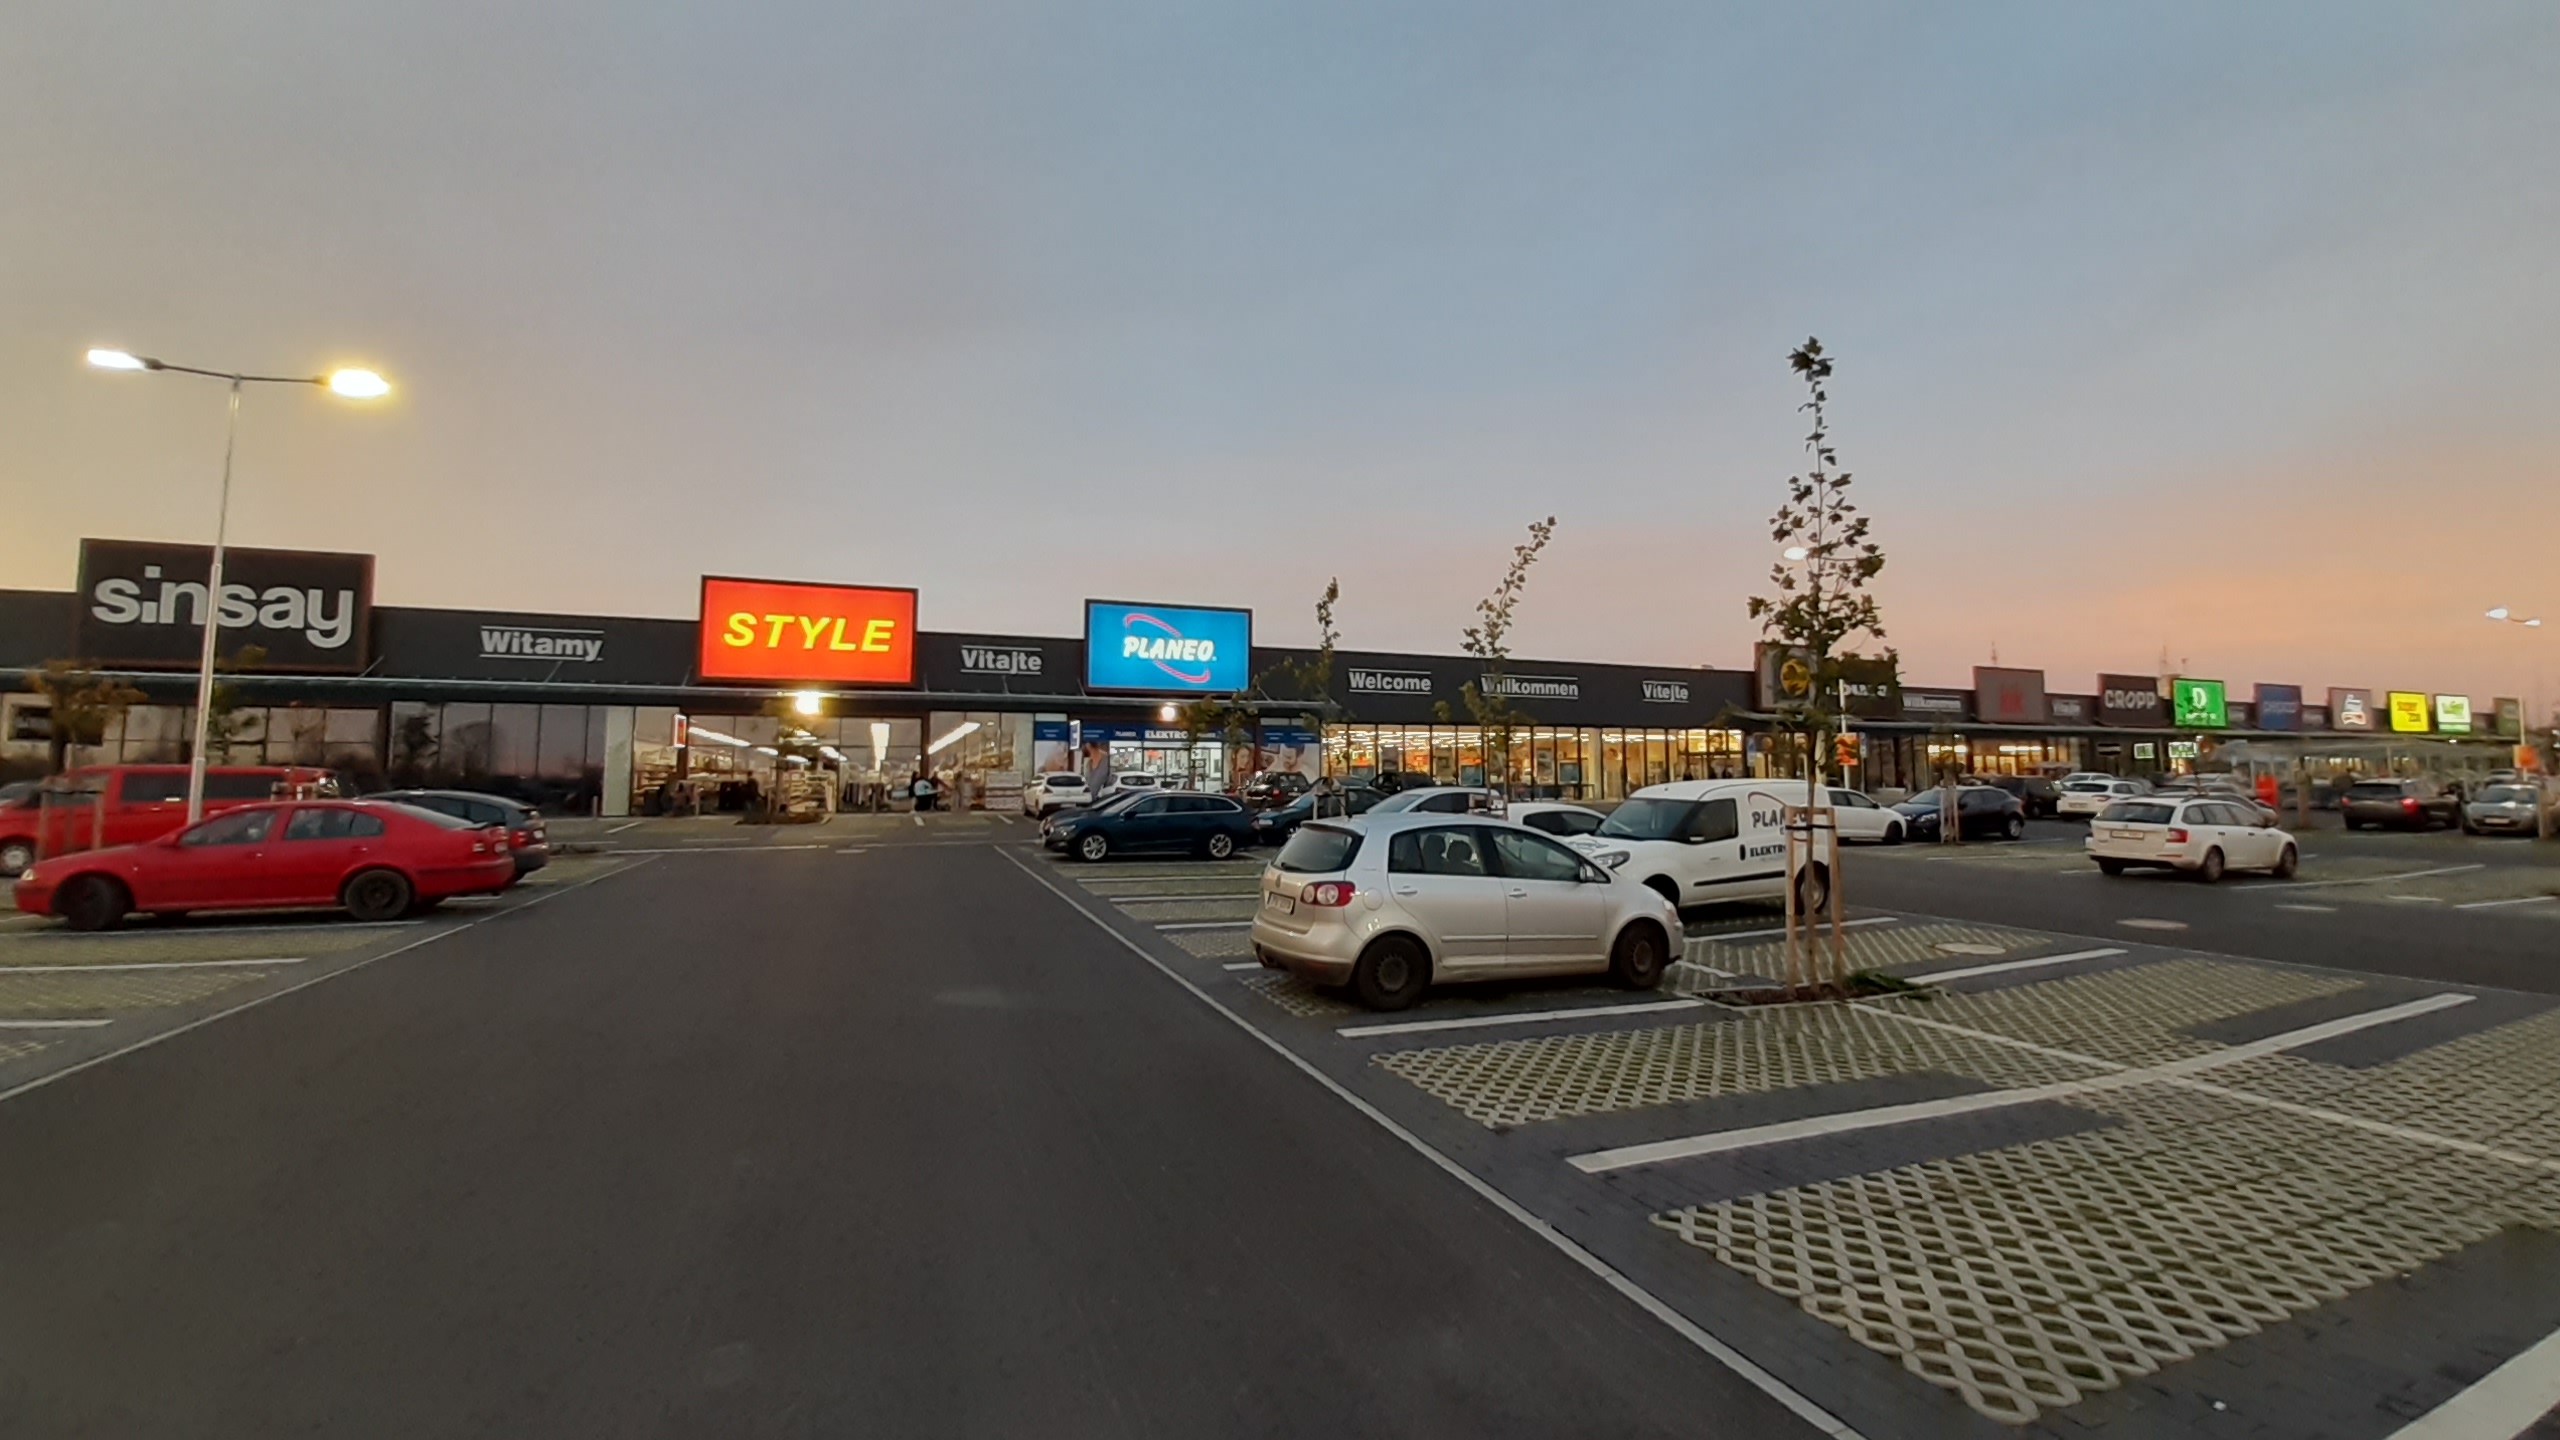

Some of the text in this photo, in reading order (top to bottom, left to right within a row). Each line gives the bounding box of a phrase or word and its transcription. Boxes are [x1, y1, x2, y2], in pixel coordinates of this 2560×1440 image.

[92, 565, 354, 648] sinsay
[723, 612, 895, 652] STYLE
[481, 630, 603, 662] Witamy
[1122, 636, 1216, 662] PLANEO
[961, 649, 1042, 674] Vitajte
[1349, 671, 1432, 692] Welcome
[1643, 682, 1689, 702] Vitejte
[2104, 689, 2157, 710] CROPP
[1751, 806, 1808, 828] PLANO
[1749, 843, 1787, 857] ELEKTR
